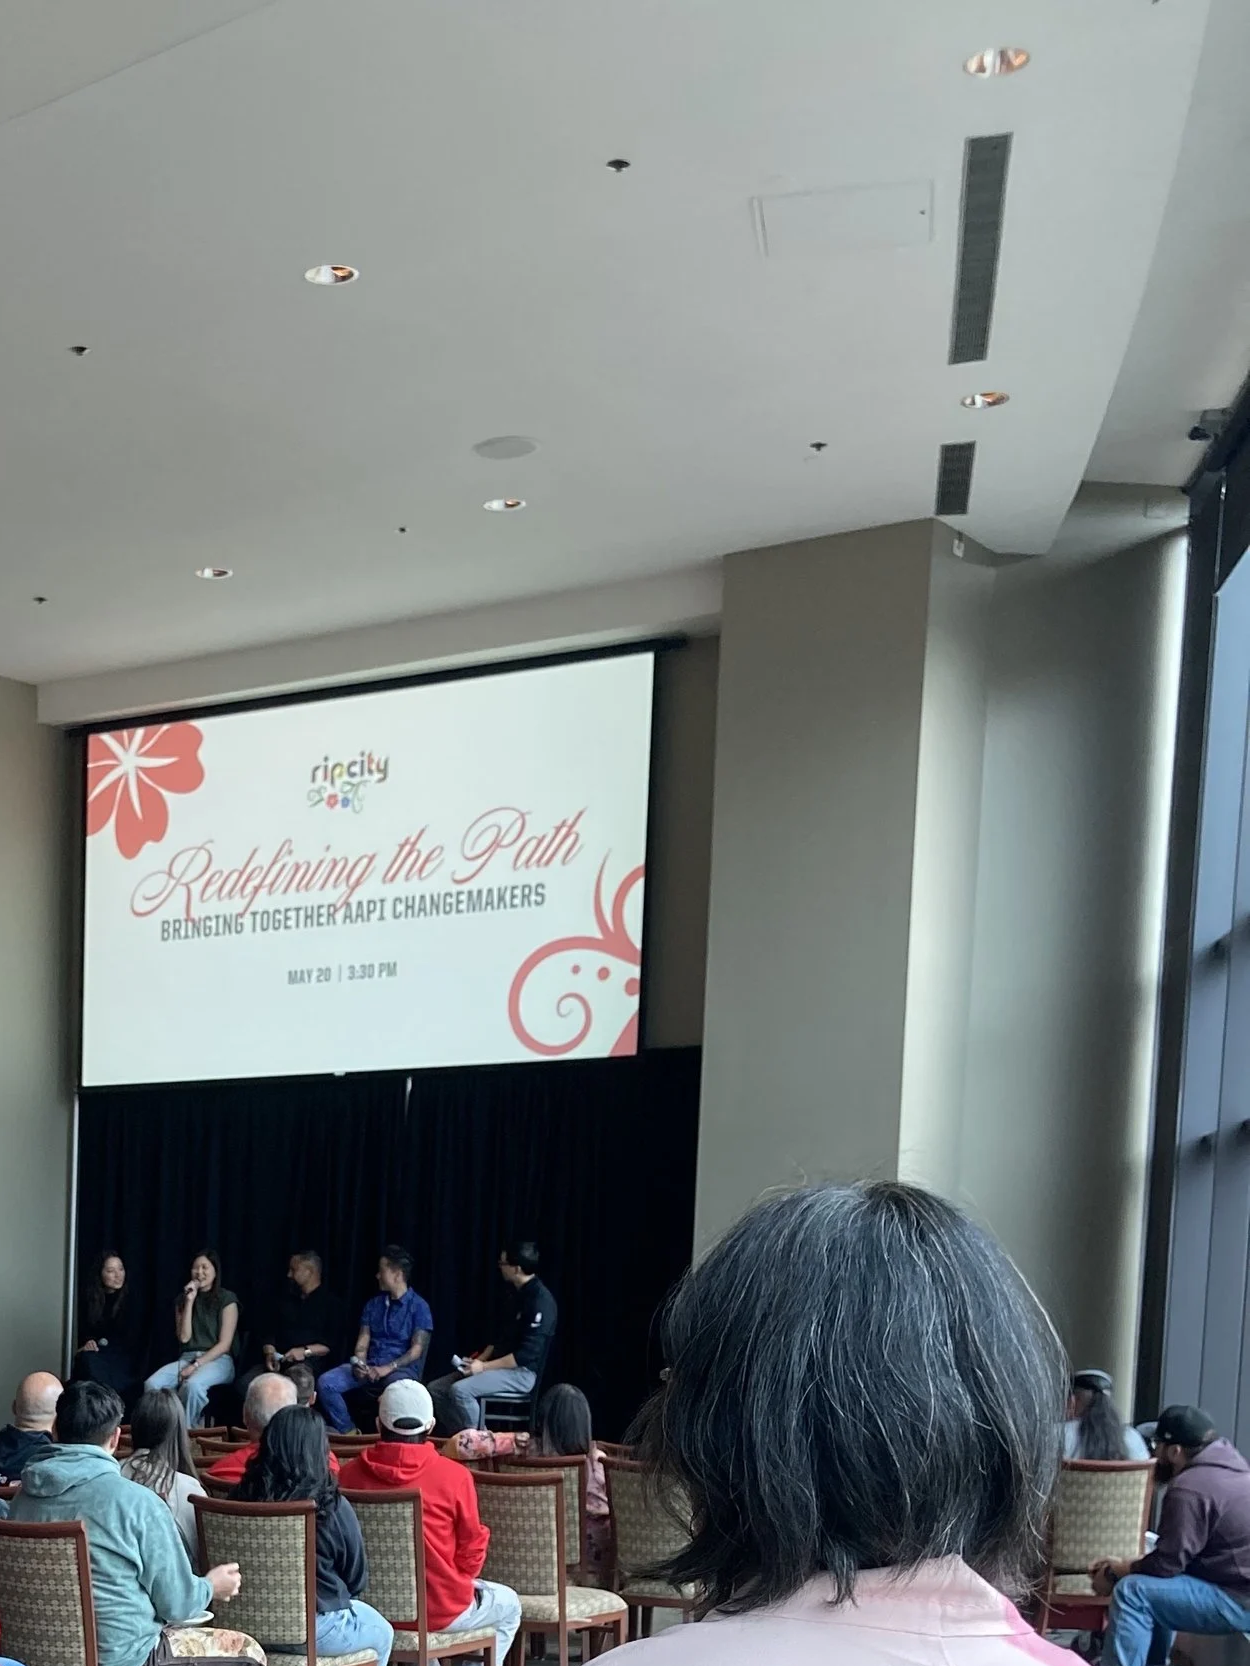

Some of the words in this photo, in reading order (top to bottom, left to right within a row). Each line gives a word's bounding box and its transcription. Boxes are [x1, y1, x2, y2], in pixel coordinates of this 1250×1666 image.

[131, 838, 379, 922] Redefining
[382, 824, 445, 884] the
[451, 806, 587, 884] Path
[161, 914, 244, 942] BRINGING
[251, 904, 337, 934] TOGETHER
[342, 898, 386, 924] AAPI
[392, 883, 546, 920] CHANGEMAKERS
[288, 968, 313, 985] MAY
[316, 966, 331, 983] 20
[348, 963, 375, 980] 3:30
[378, 961, 397, 978] PM
